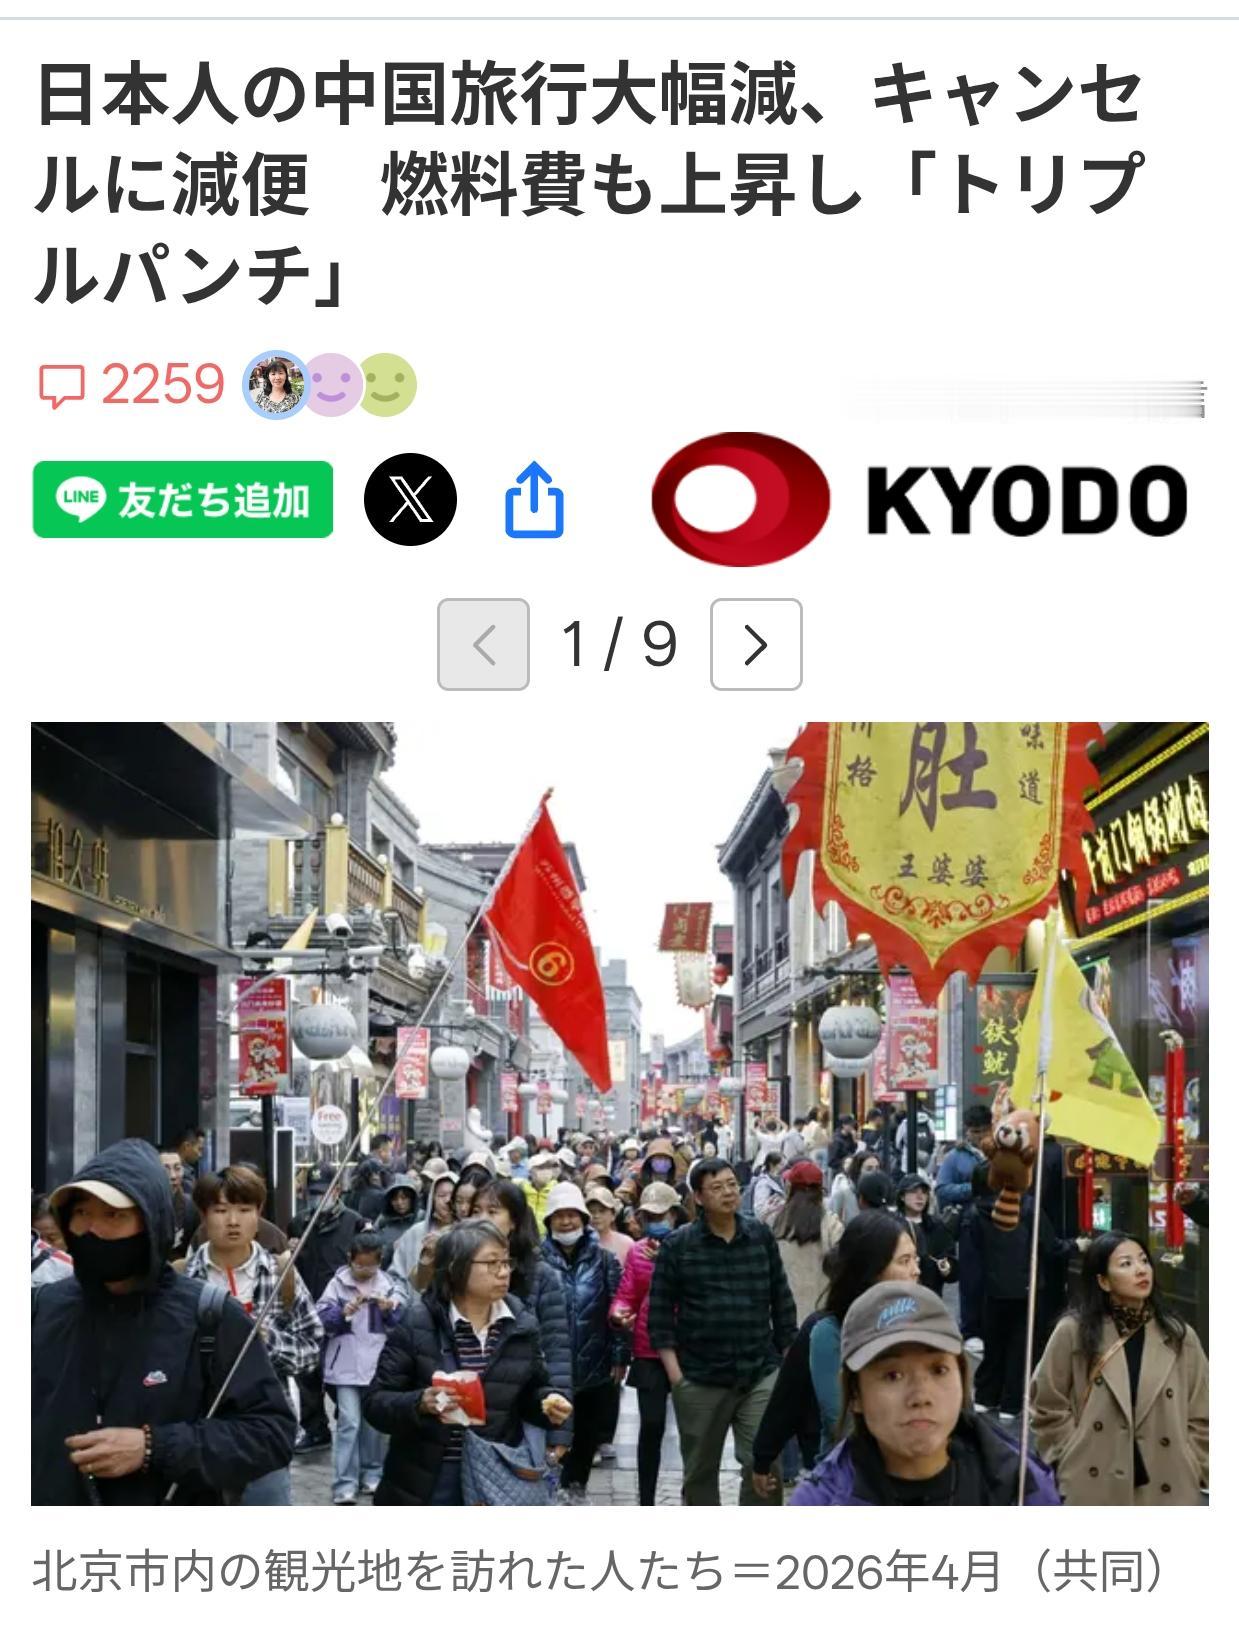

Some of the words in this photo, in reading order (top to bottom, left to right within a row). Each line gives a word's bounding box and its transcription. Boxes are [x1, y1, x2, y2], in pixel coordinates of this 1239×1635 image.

[899, 722, 998, 832] 肚
[1018, 722, 1044, 805] 味道
[897, 852, 989, 889] 王婆婆
[537, 951, 567, 978] 6
[317, 1111, 342, 1121] Free
